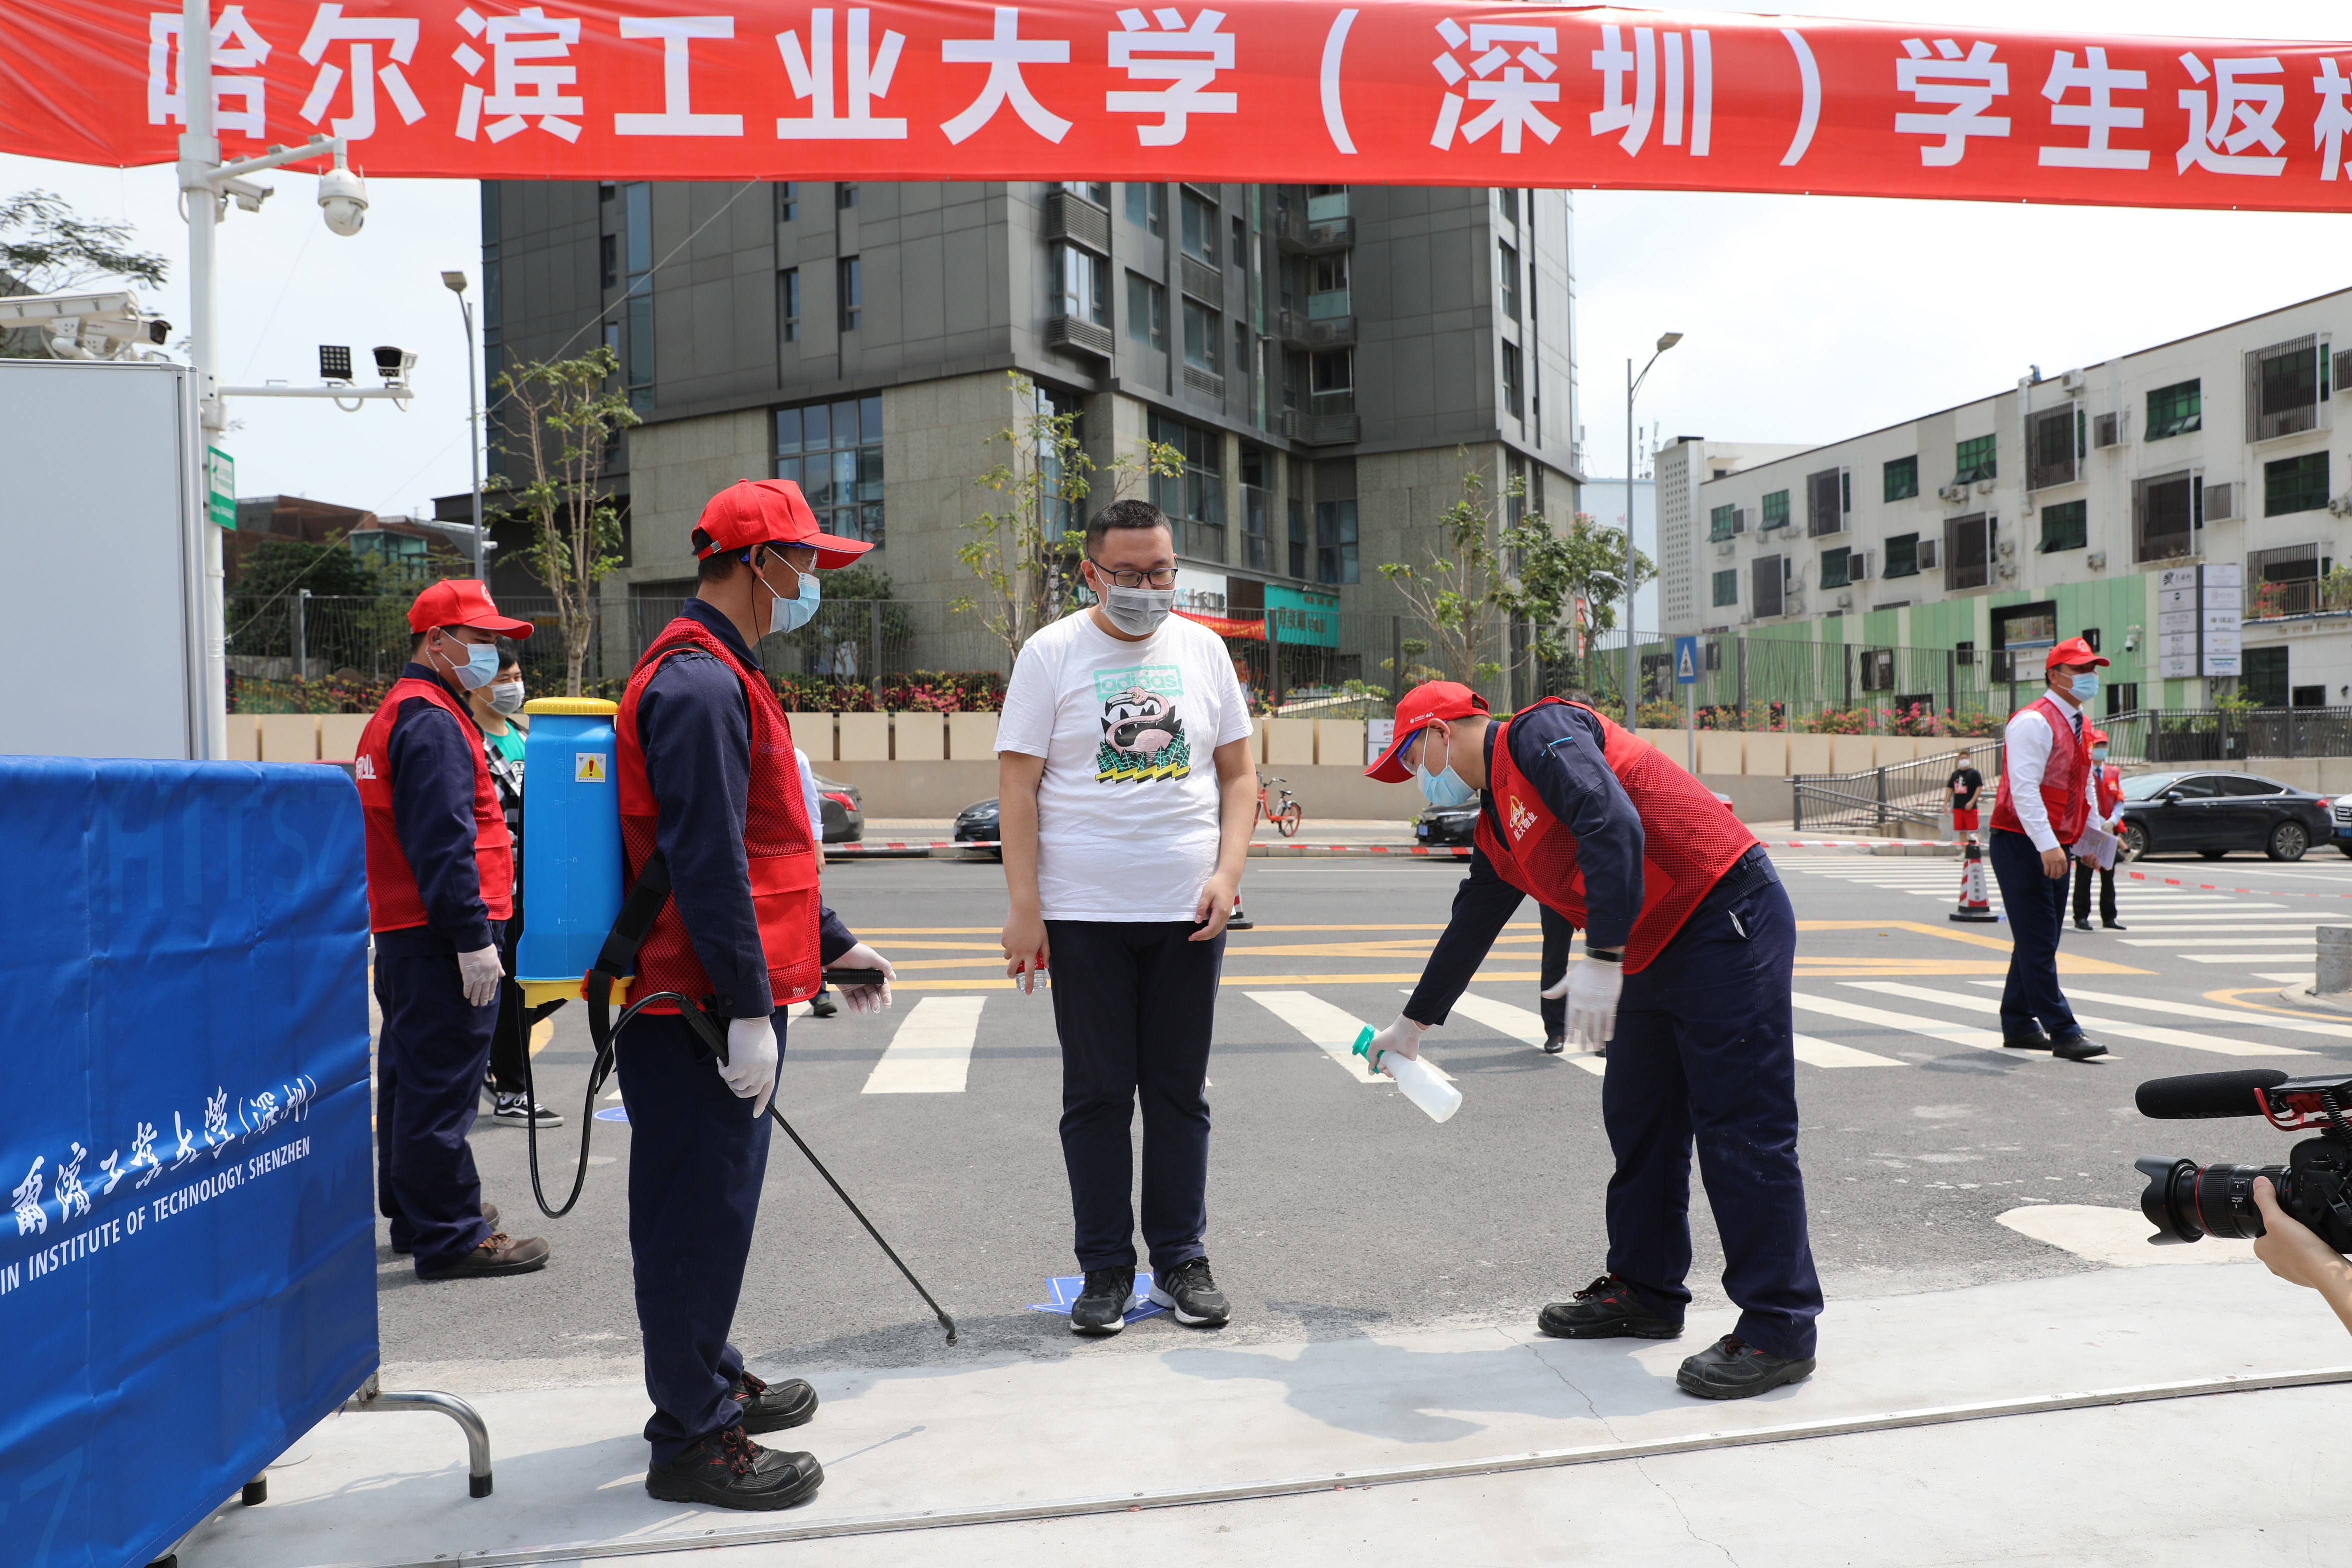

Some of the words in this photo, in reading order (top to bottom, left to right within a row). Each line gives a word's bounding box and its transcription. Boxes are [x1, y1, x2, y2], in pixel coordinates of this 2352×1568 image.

[1102, 672, 1178, 692] adidas
[1514, 812, 1538, 842] 航天物业
[28, 1218, 121, 1281] INSTITUTE
[126, 1207, 146, 1236] OF
[153, 1164, 246, 1223] TECHNOLOGY,
[249, 1136, 310, 1181] SHENZHEN
